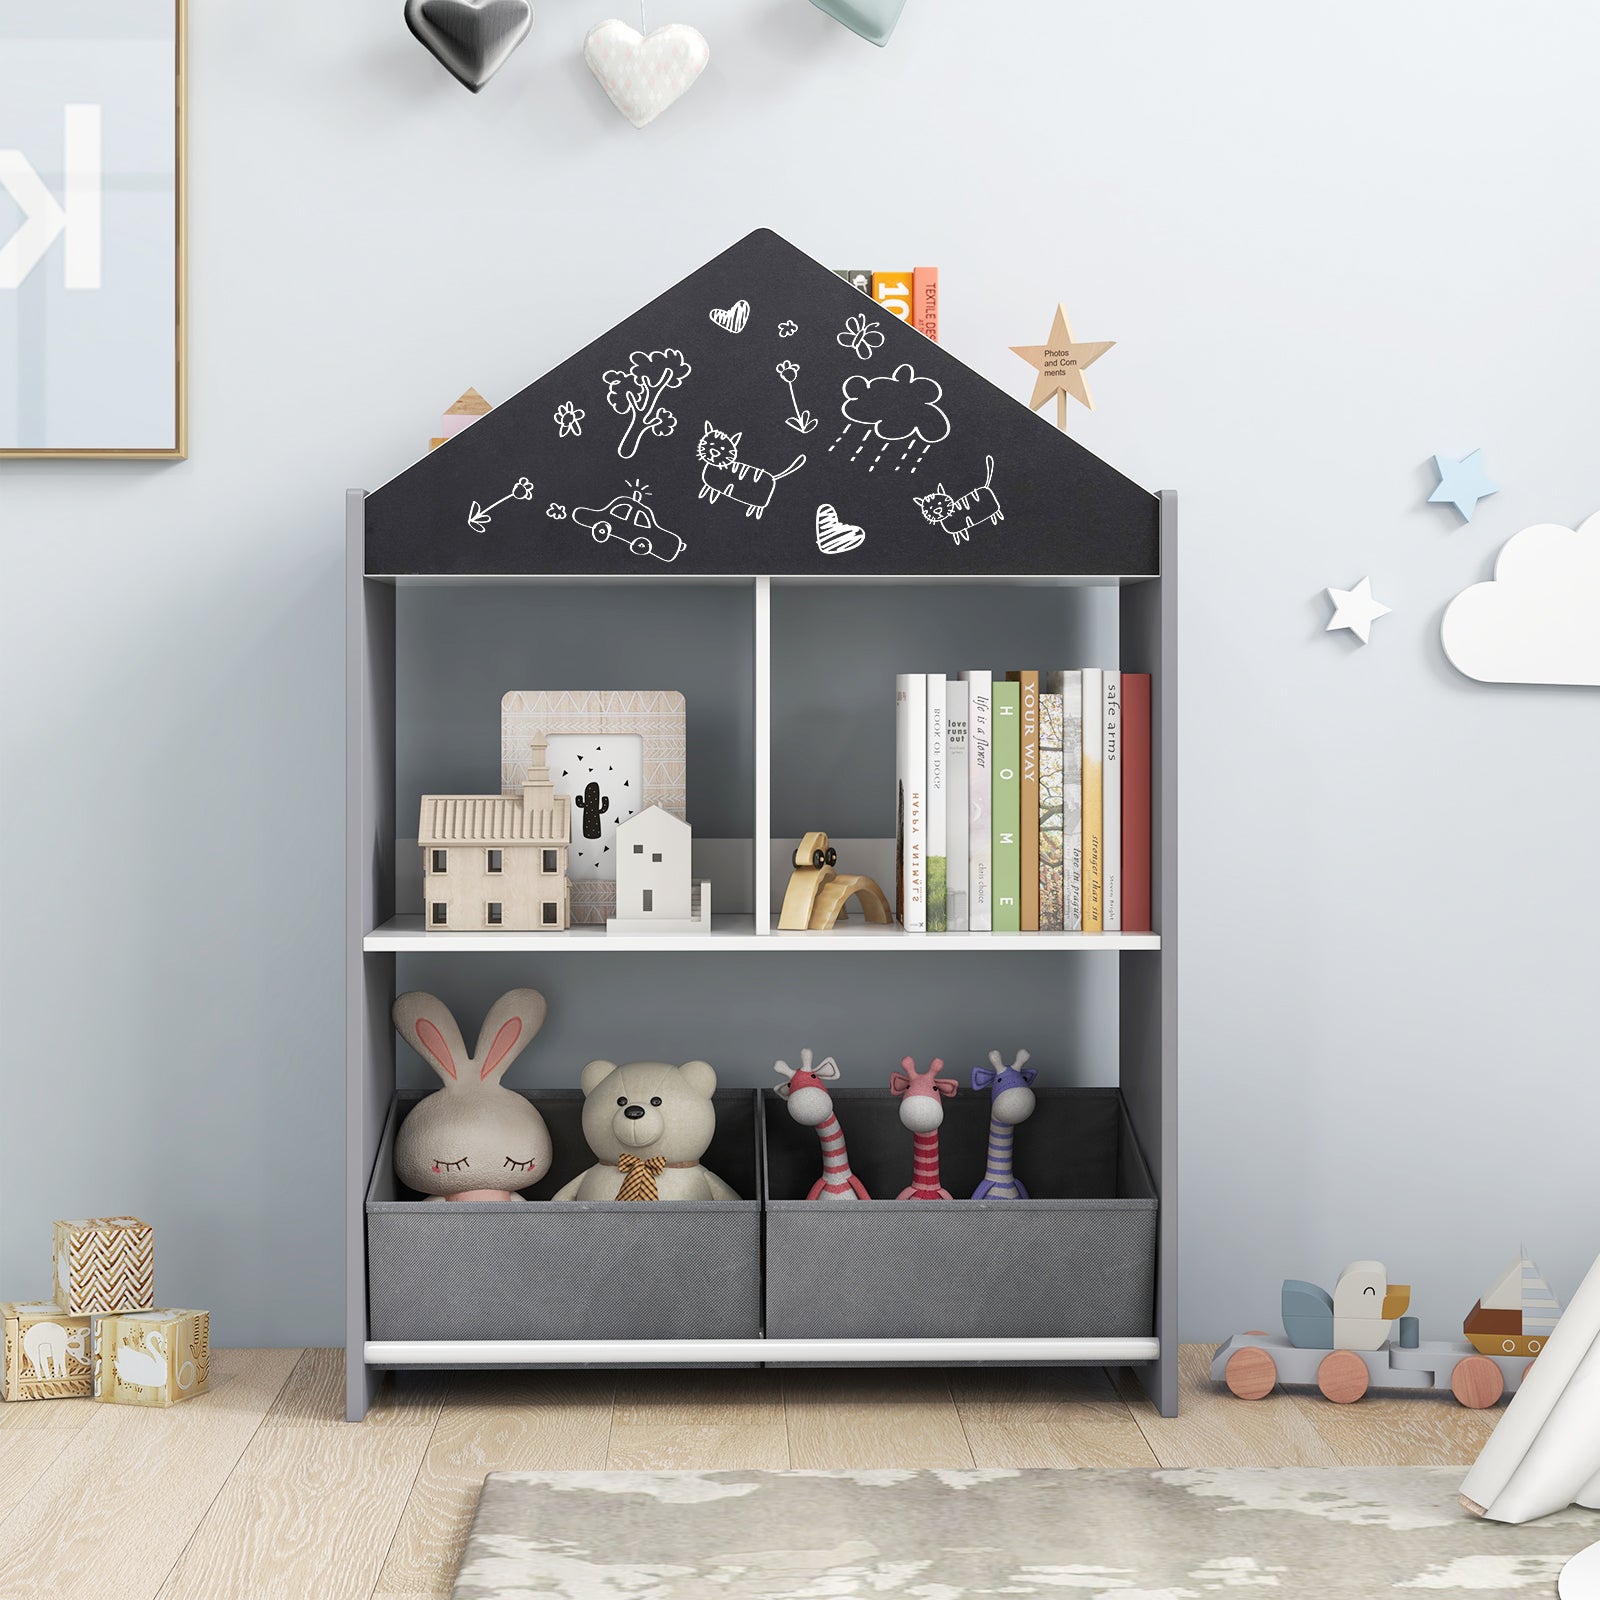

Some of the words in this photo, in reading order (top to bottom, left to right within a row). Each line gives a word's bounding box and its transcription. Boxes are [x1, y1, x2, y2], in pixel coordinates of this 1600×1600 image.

[925, 283, 936, 320] TEXTILE
[1044, 349, 1070, 357] Photos
[1044, 359, 1058, 367] and
[1059, 358, 1077, 367] Com
[1044, 369, 1066, 377] ments
[973, 695, 990, 714] life
[1024, 682, 1035, 736] YOUR
[1107, 684, 1120, 719] safe
[947, 719, 967, 728] love
[976, 715, 987, 728] is
[949, 735, 965, 743] out
[1107, 722, 1117, 761] arms
[973, 735, 990, 769] flower
[1024, 742, 1035, 782] WAY
[1073, 848, 1082, 868] love
[1089, 835, 1099, 876] stronger
[1071, 883, 1080, 920] prague
[1092, 879, 1101, 903] than
